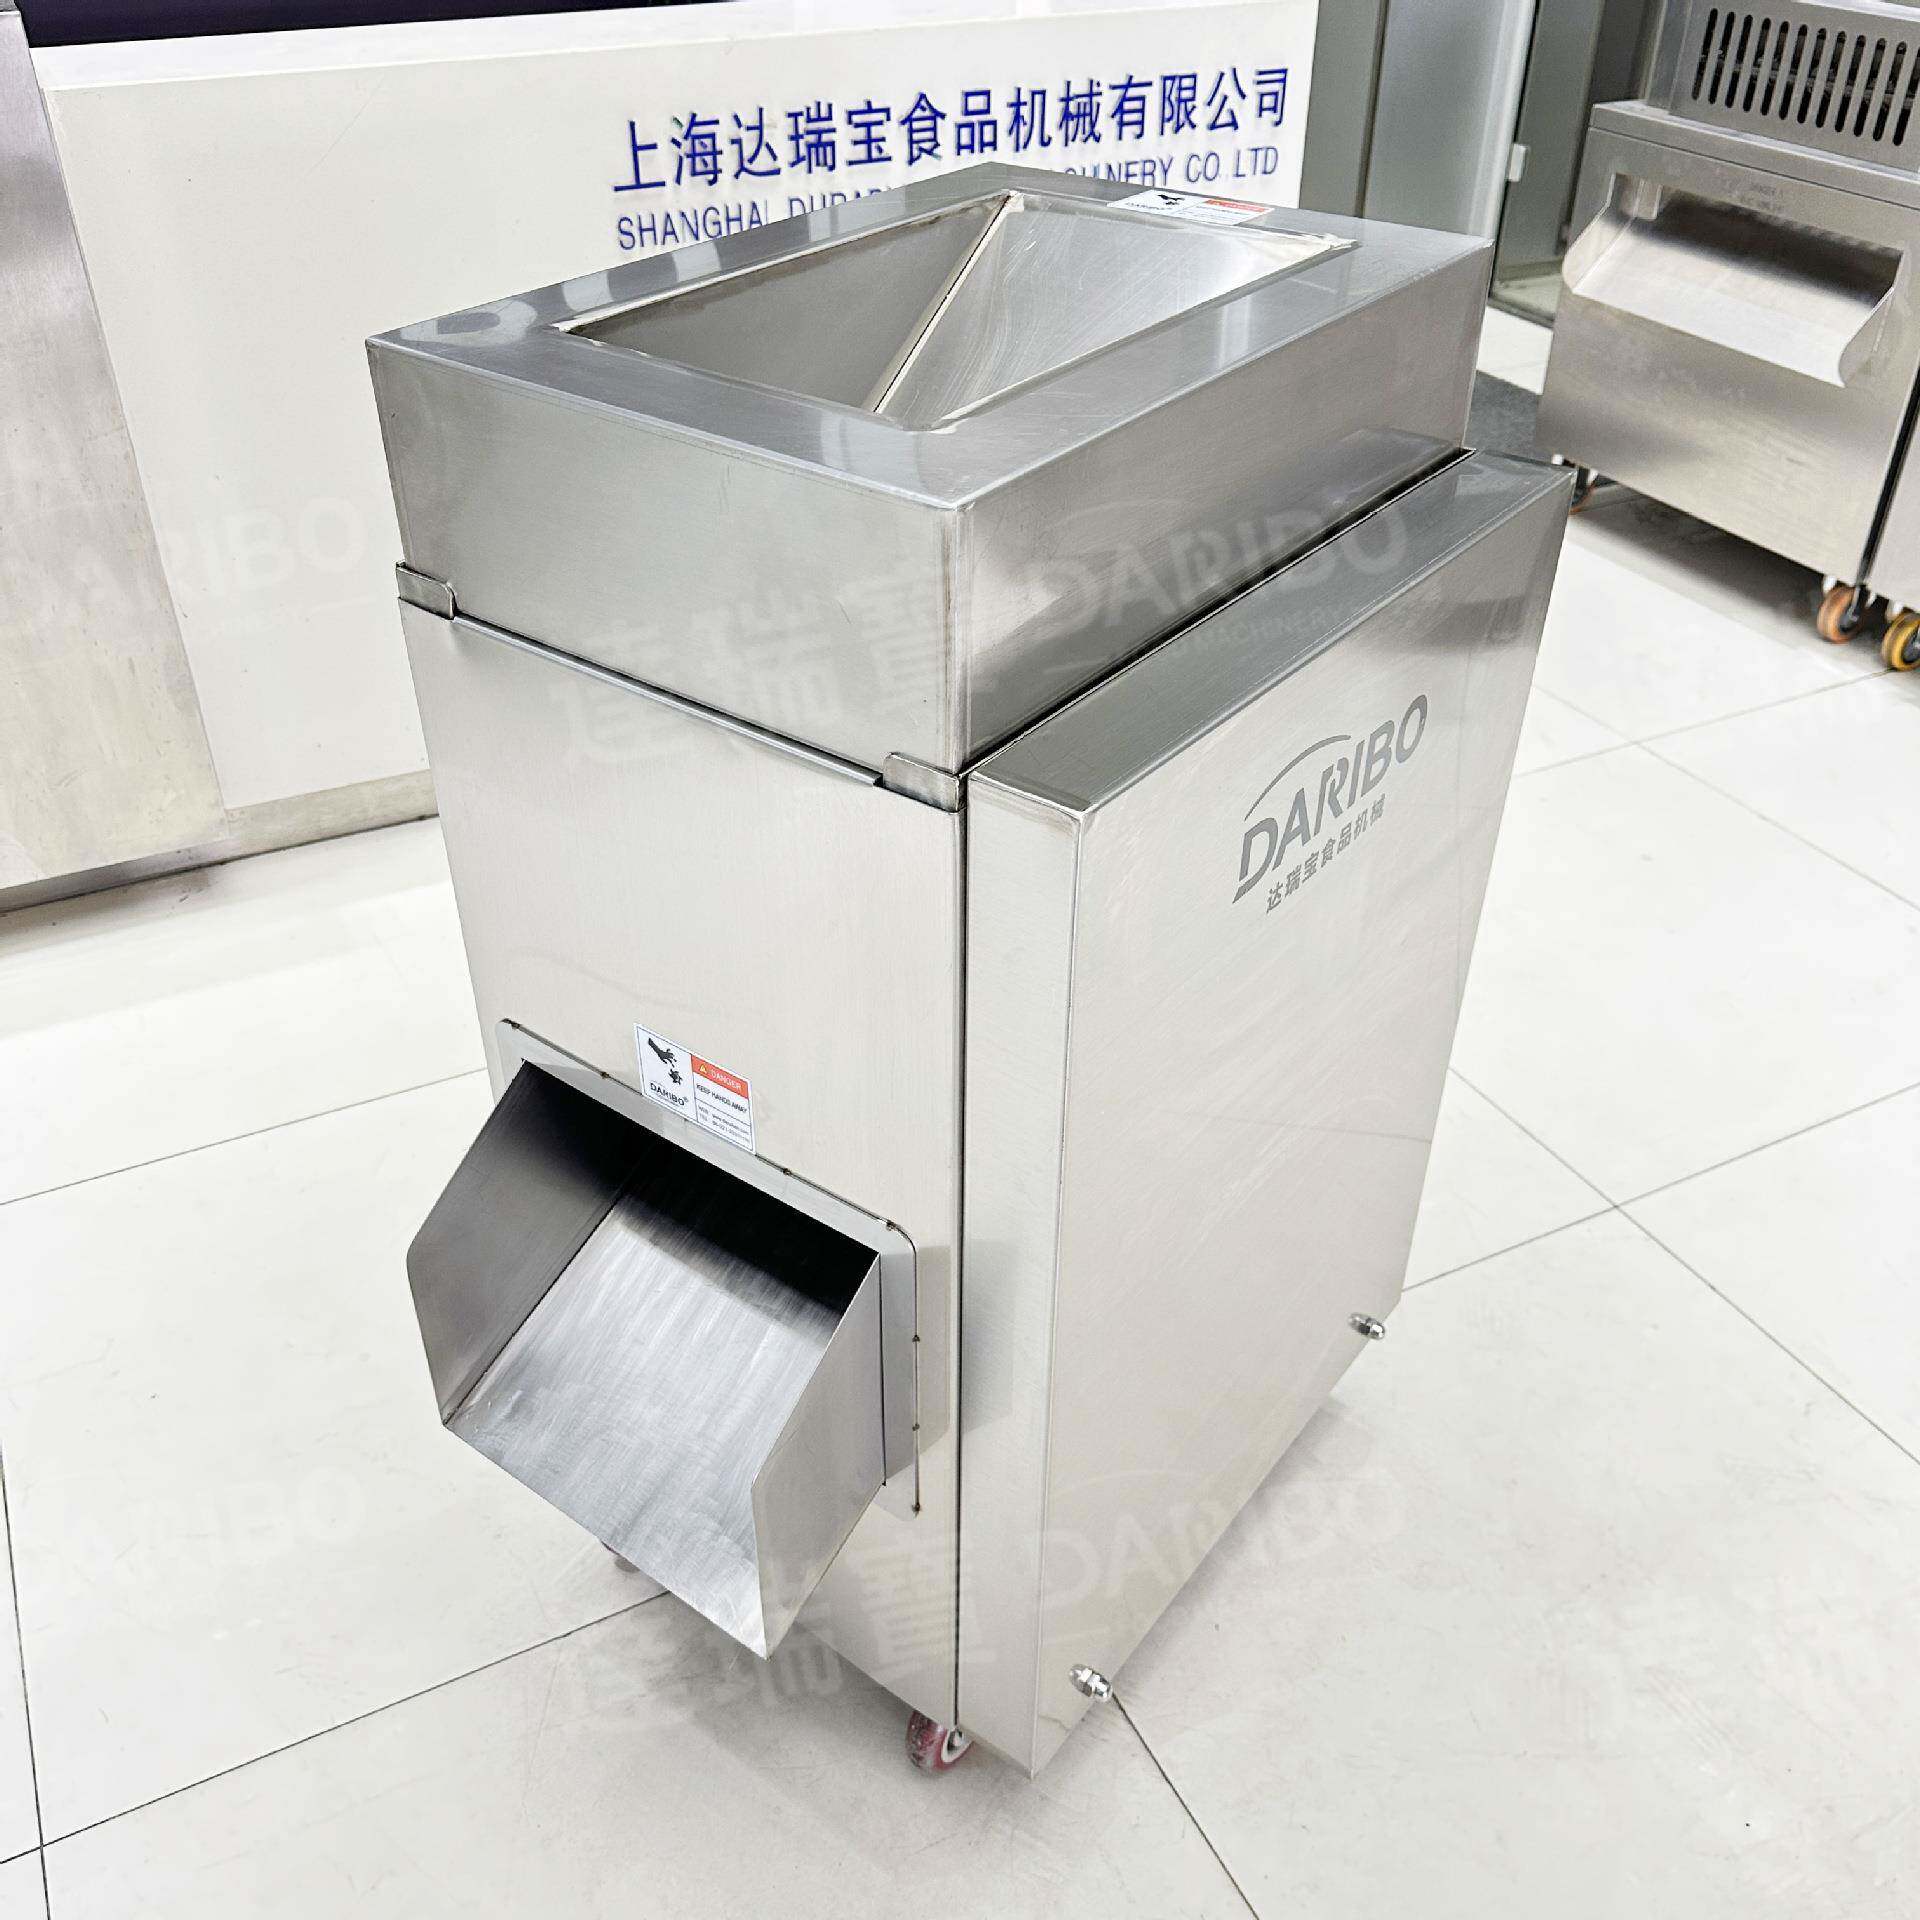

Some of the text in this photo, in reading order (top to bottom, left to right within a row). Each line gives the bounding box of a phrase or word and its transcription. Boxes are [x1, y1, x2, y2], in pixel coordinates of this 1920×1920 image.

[613, 66, 1290, 194] 上海达瑞宝食品机械有限公司
[1233, 694, 1428, 904] DARIBO
[1266, 793, 1386, 914] 达瑞宝食品机械
